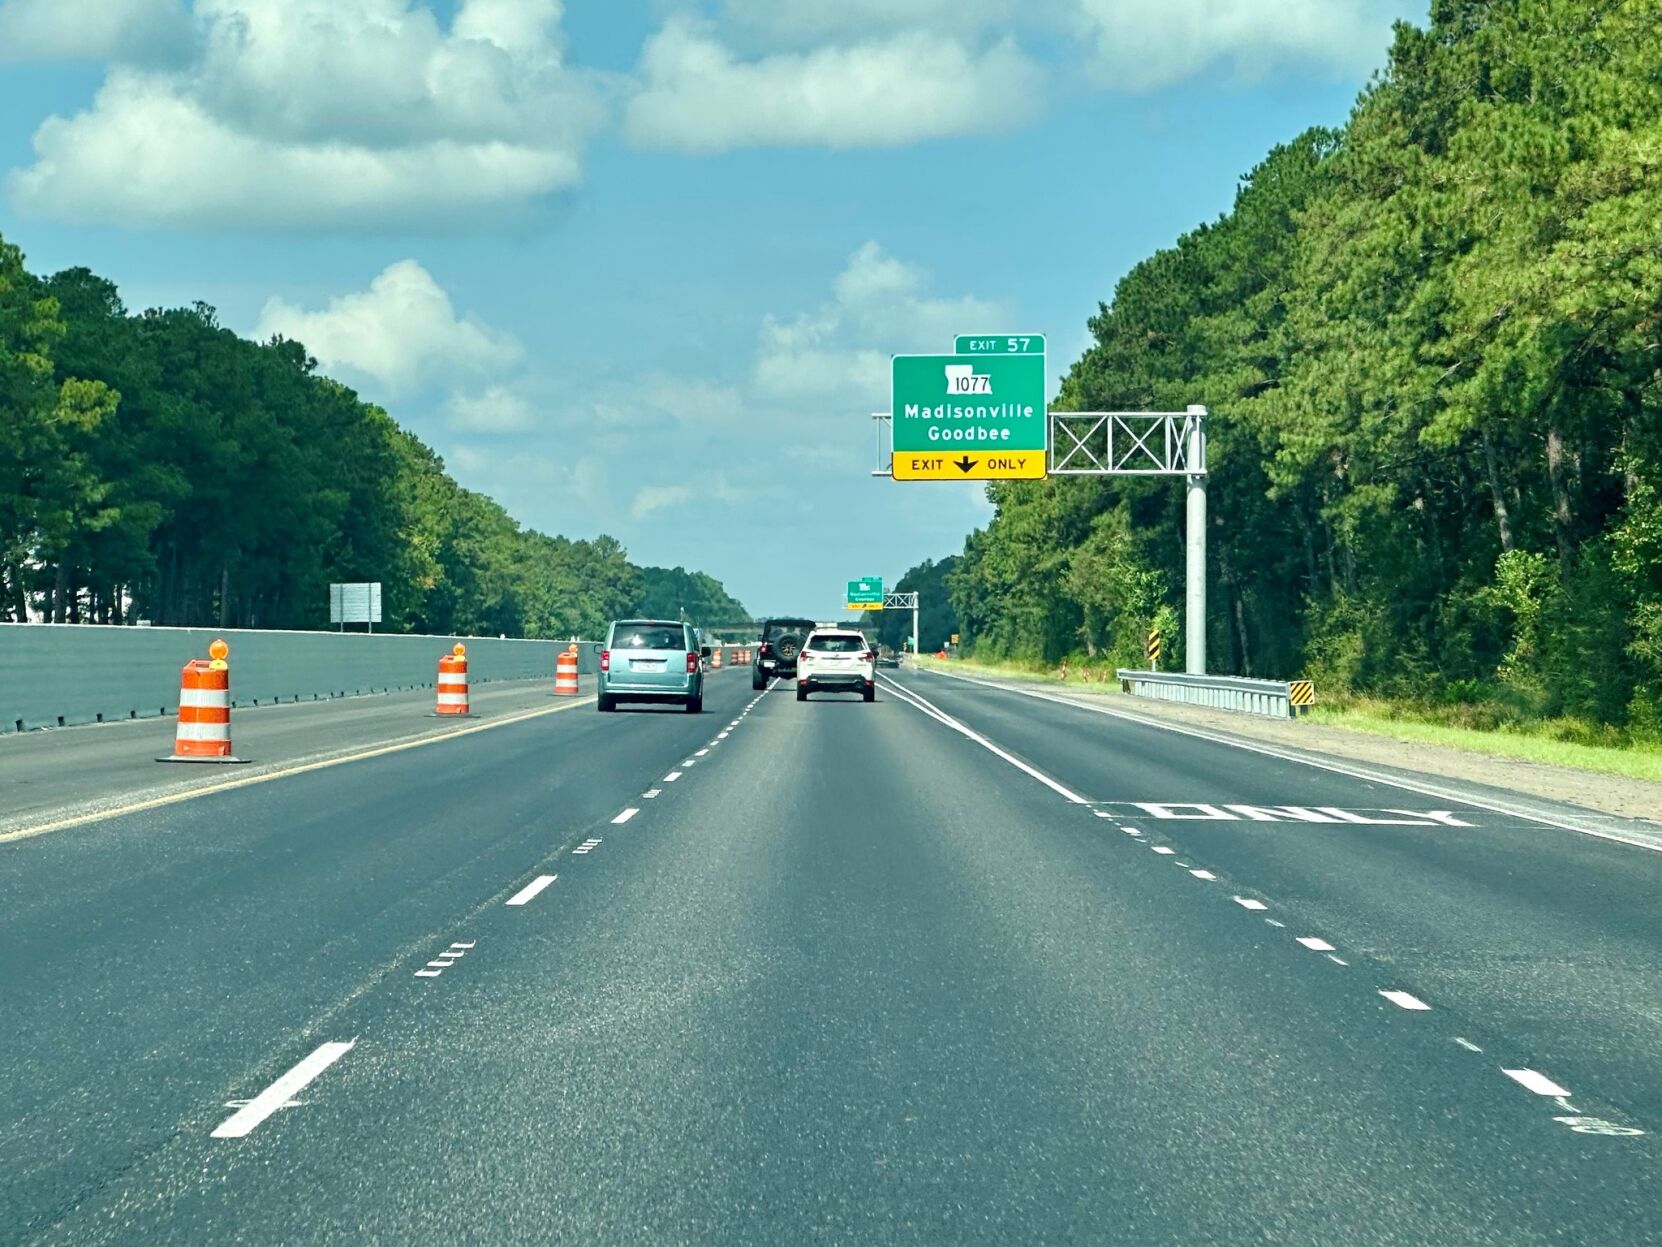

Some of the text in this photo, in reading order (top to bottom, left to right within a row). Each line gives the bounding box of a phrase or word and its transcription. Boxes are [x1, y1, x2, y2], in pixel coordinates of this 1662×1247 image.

[969, 338, 1030, 352] EXIT 57
[955, 377, 988, 391] 1077
[905, 404, 1033, 418] Madisonville
[928, 426, 1010, 440] Goodbee
[912, 459, 1026, 470] EXIT ONLY
[1131, 802, 1481, 827] ONLY
